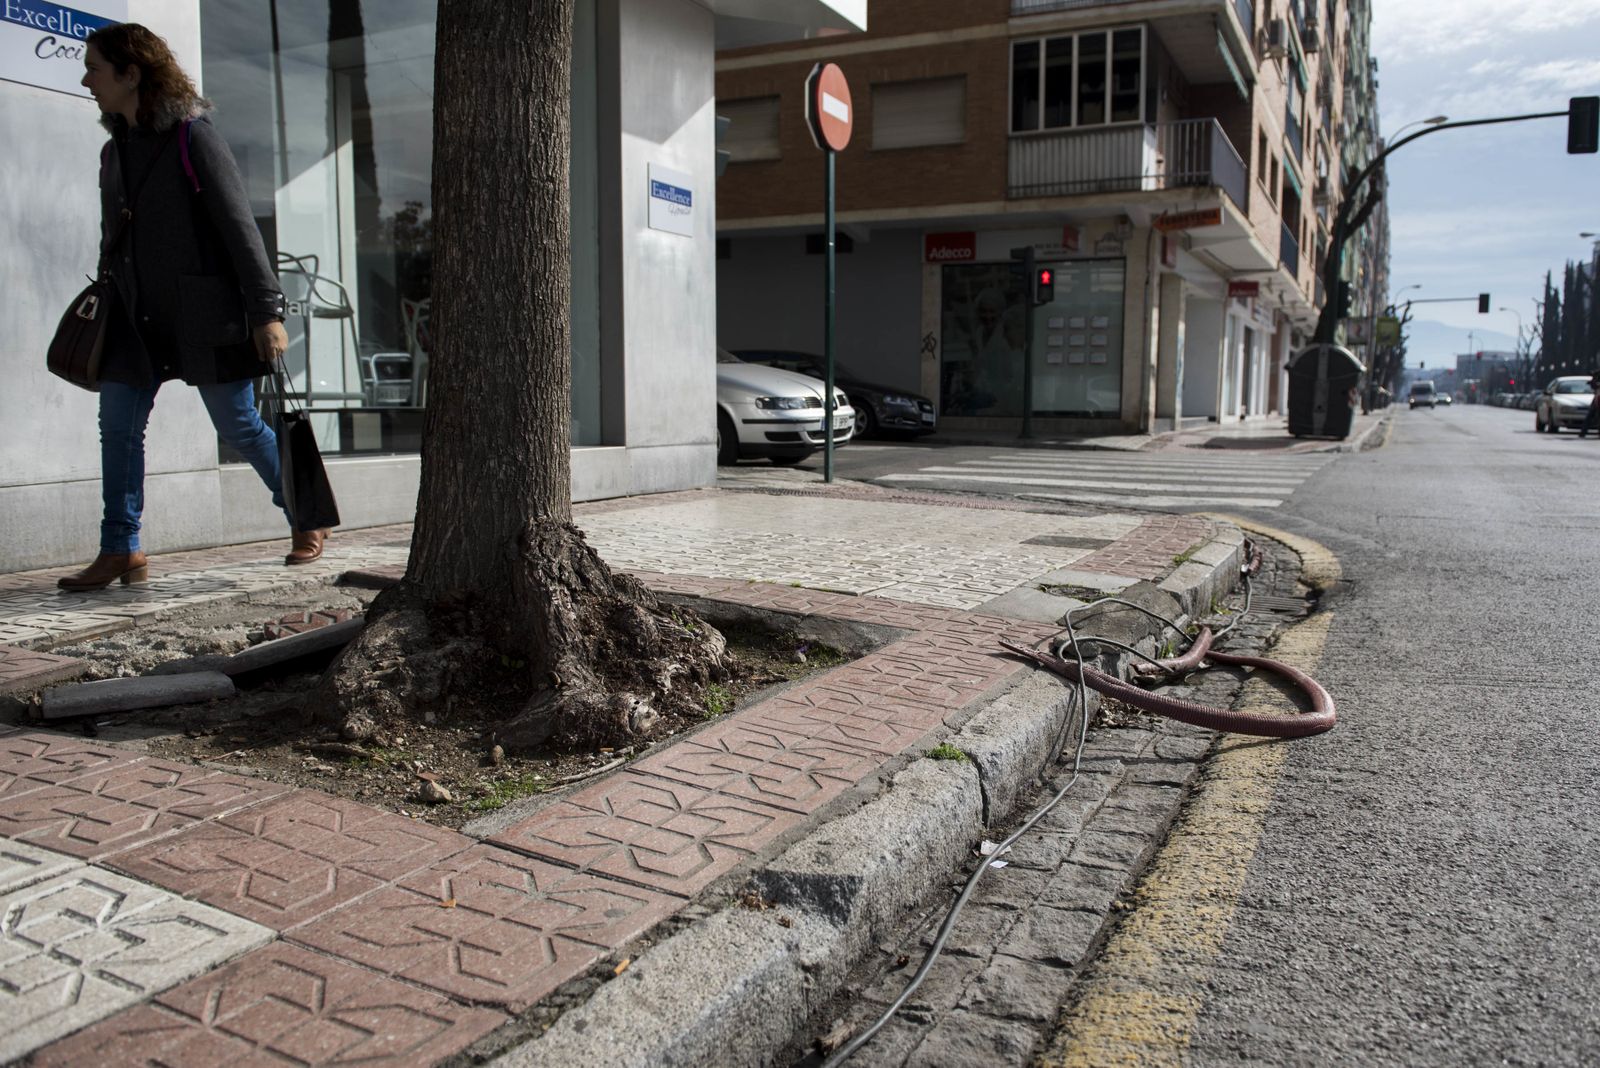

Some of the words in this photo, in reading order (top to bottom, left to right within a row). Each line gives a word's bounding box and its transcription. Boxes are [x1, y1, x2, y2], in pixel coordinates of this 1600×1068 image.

[4, 0, 98, 39] Excellen
[35, 35, 84, 60] Coci
[653, 182, 690, 205] Excellence
[929, 245, 972, 259] Adecco
